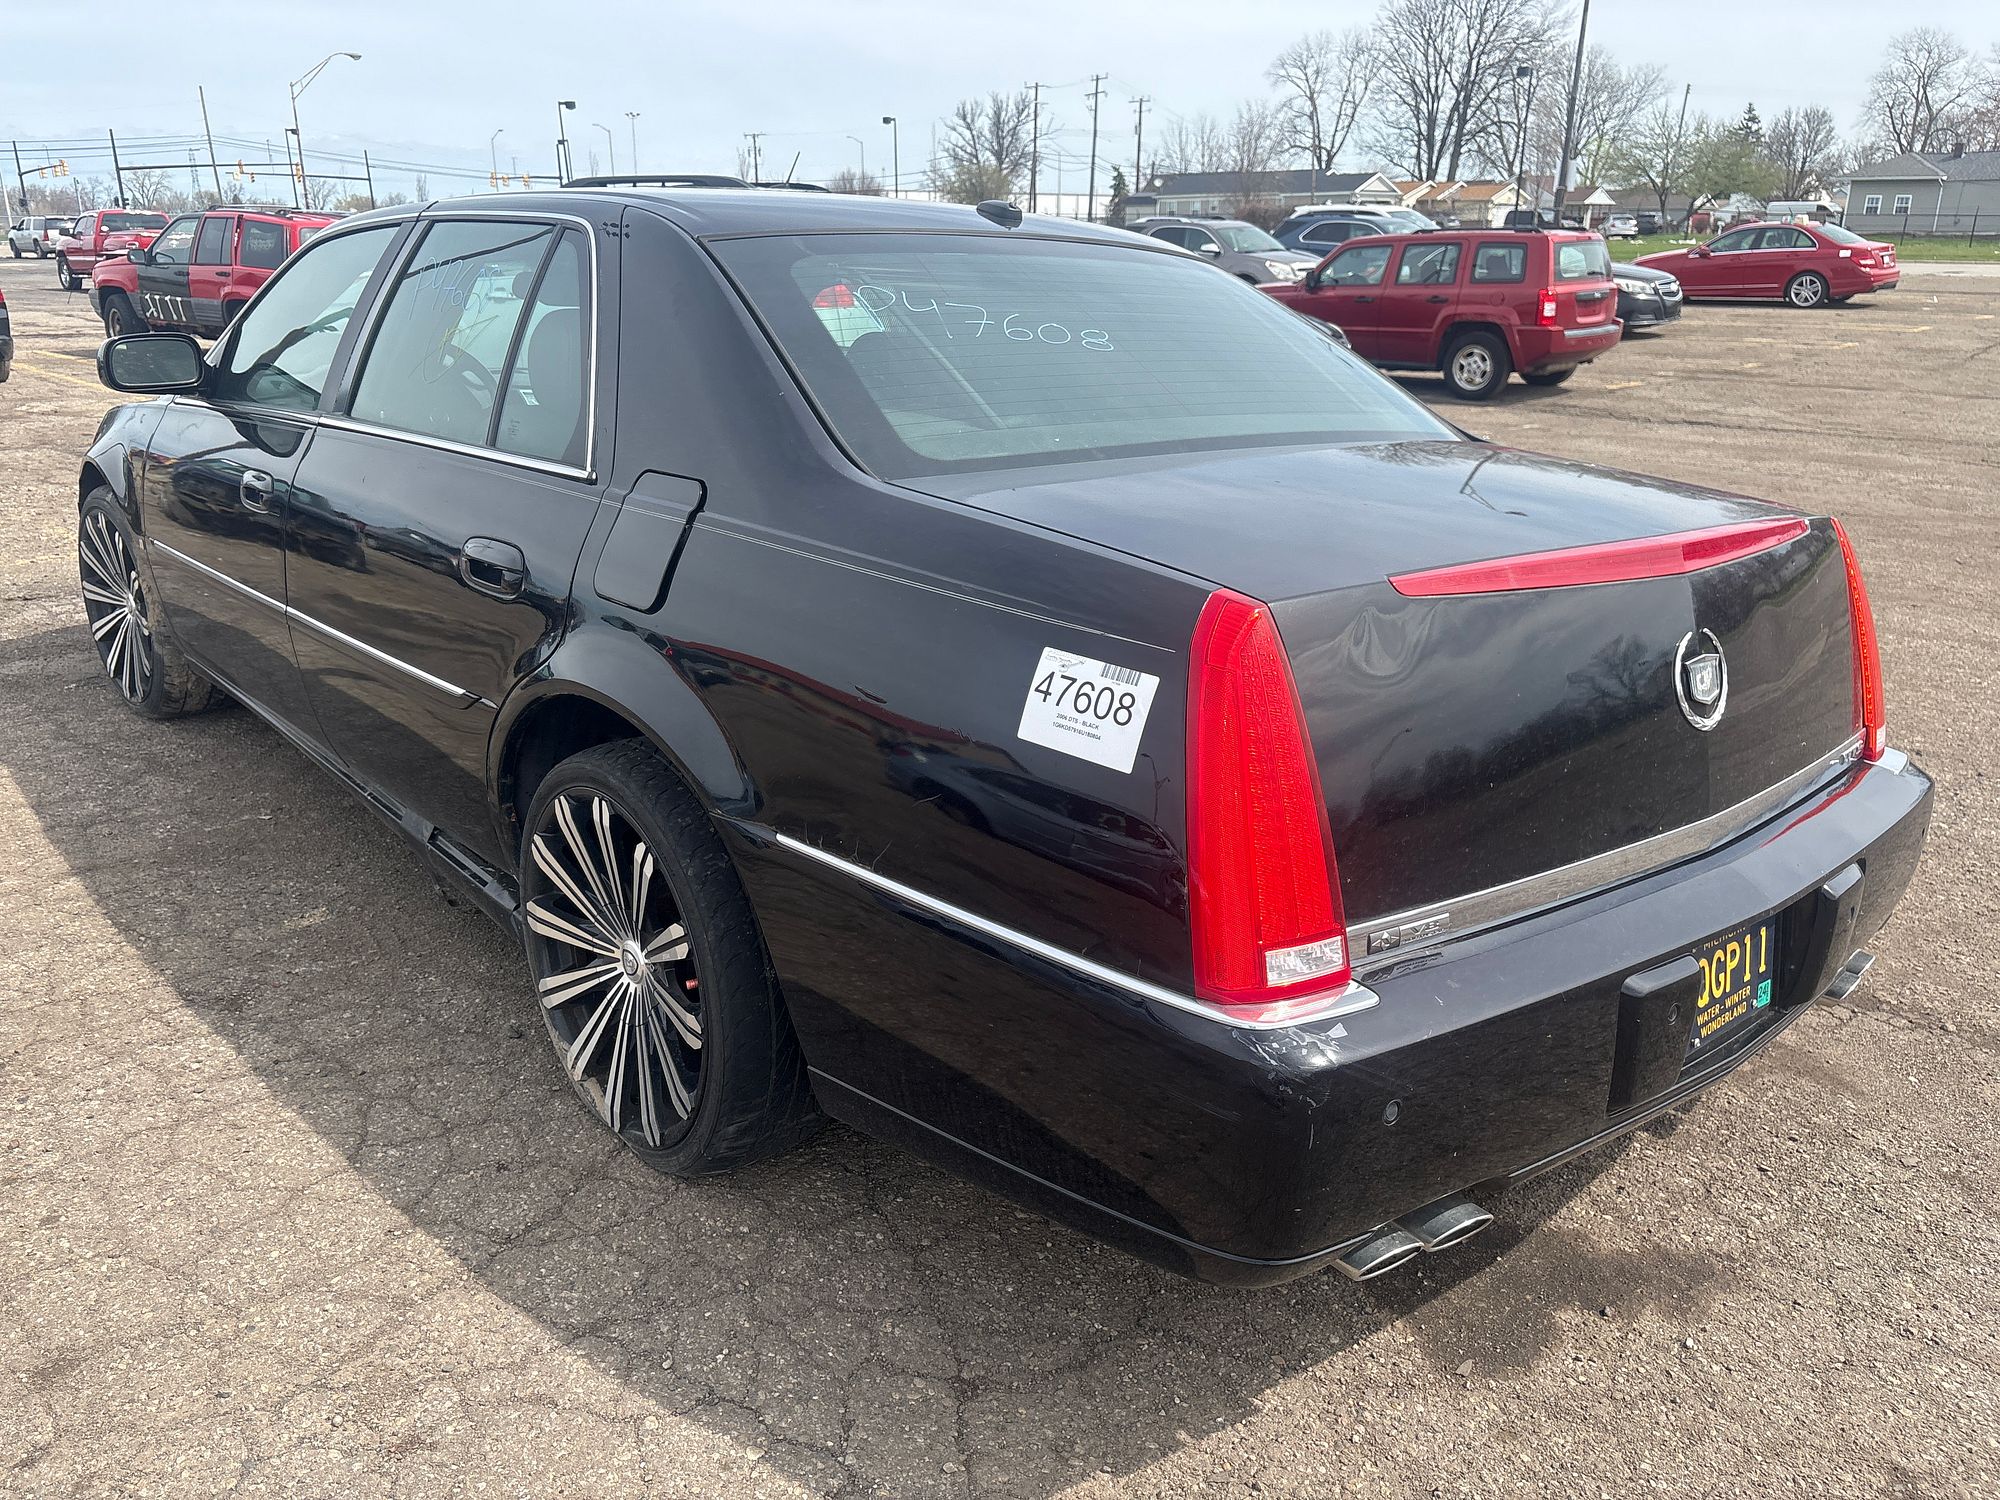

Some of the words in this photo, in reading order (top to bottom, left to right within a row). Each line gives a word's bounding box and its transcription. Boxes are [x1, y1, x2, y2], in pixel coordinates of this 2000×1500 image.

[853, 285, 1115, 352] P47608
[1034, 671, 1137, 727] 47608
[1081, 720, 1100, 730] BLACK
[1697, 1003, 1720, 1026] WATER
[1725, 985, 1751, 1009] WINTER
[1700, 1001, 1747, 1039] WONDERLAND
